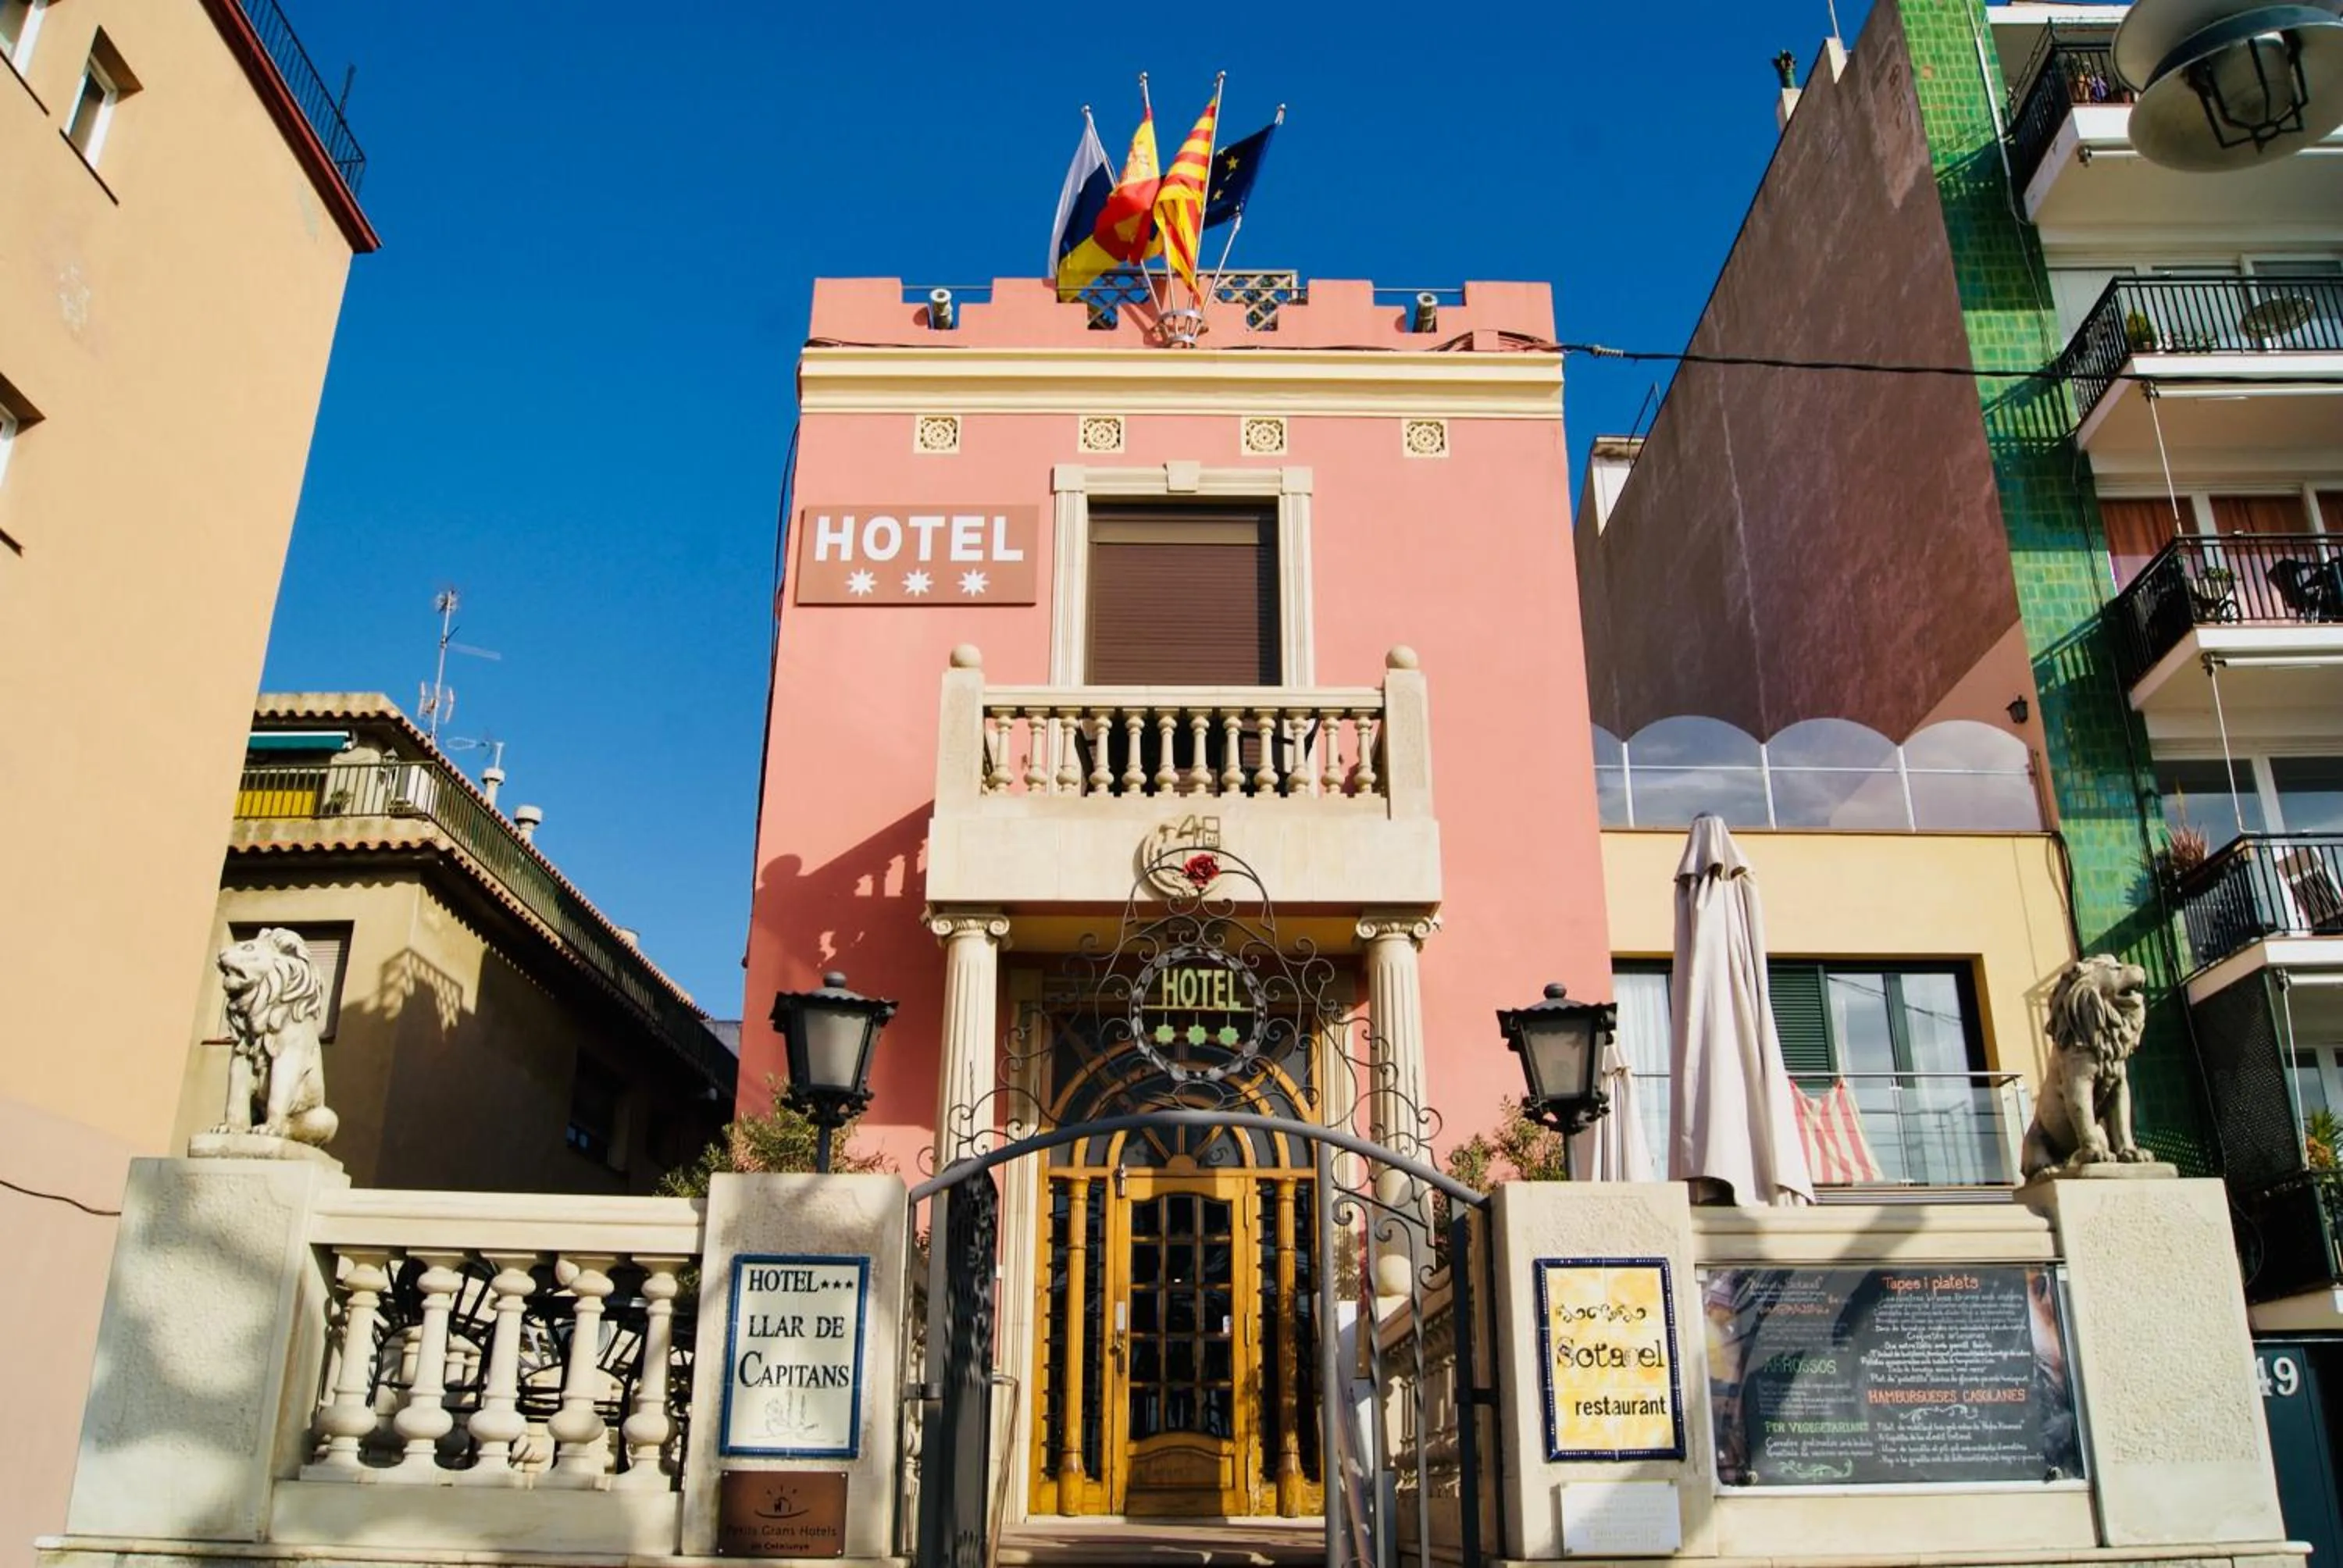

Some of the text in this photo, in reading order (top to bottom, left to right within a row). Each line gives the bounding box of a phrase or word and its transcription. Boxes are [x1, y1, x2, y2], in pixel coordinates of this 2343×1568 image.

[815, 515, 1024, 561] HOTEL
[1161, 968, 1241, 1008] HOTEL
[747, 1269, 819, 1292] HOTEL
[1881, 1277, 1920, 1294] Tapes
[1931, 1274, 1978, 1294] platets
[747, 1315, 845, 1338] LLAR DE
[1557, 1336, 1665, 1368] Sotael
[739, 1350, 850, 1388] CAPITANS
[1575, 1395, 1667, 1416] restaurant
[761, 1525, 795, 1537] Grans
[800, 1525, 837, 1538] Hotels
